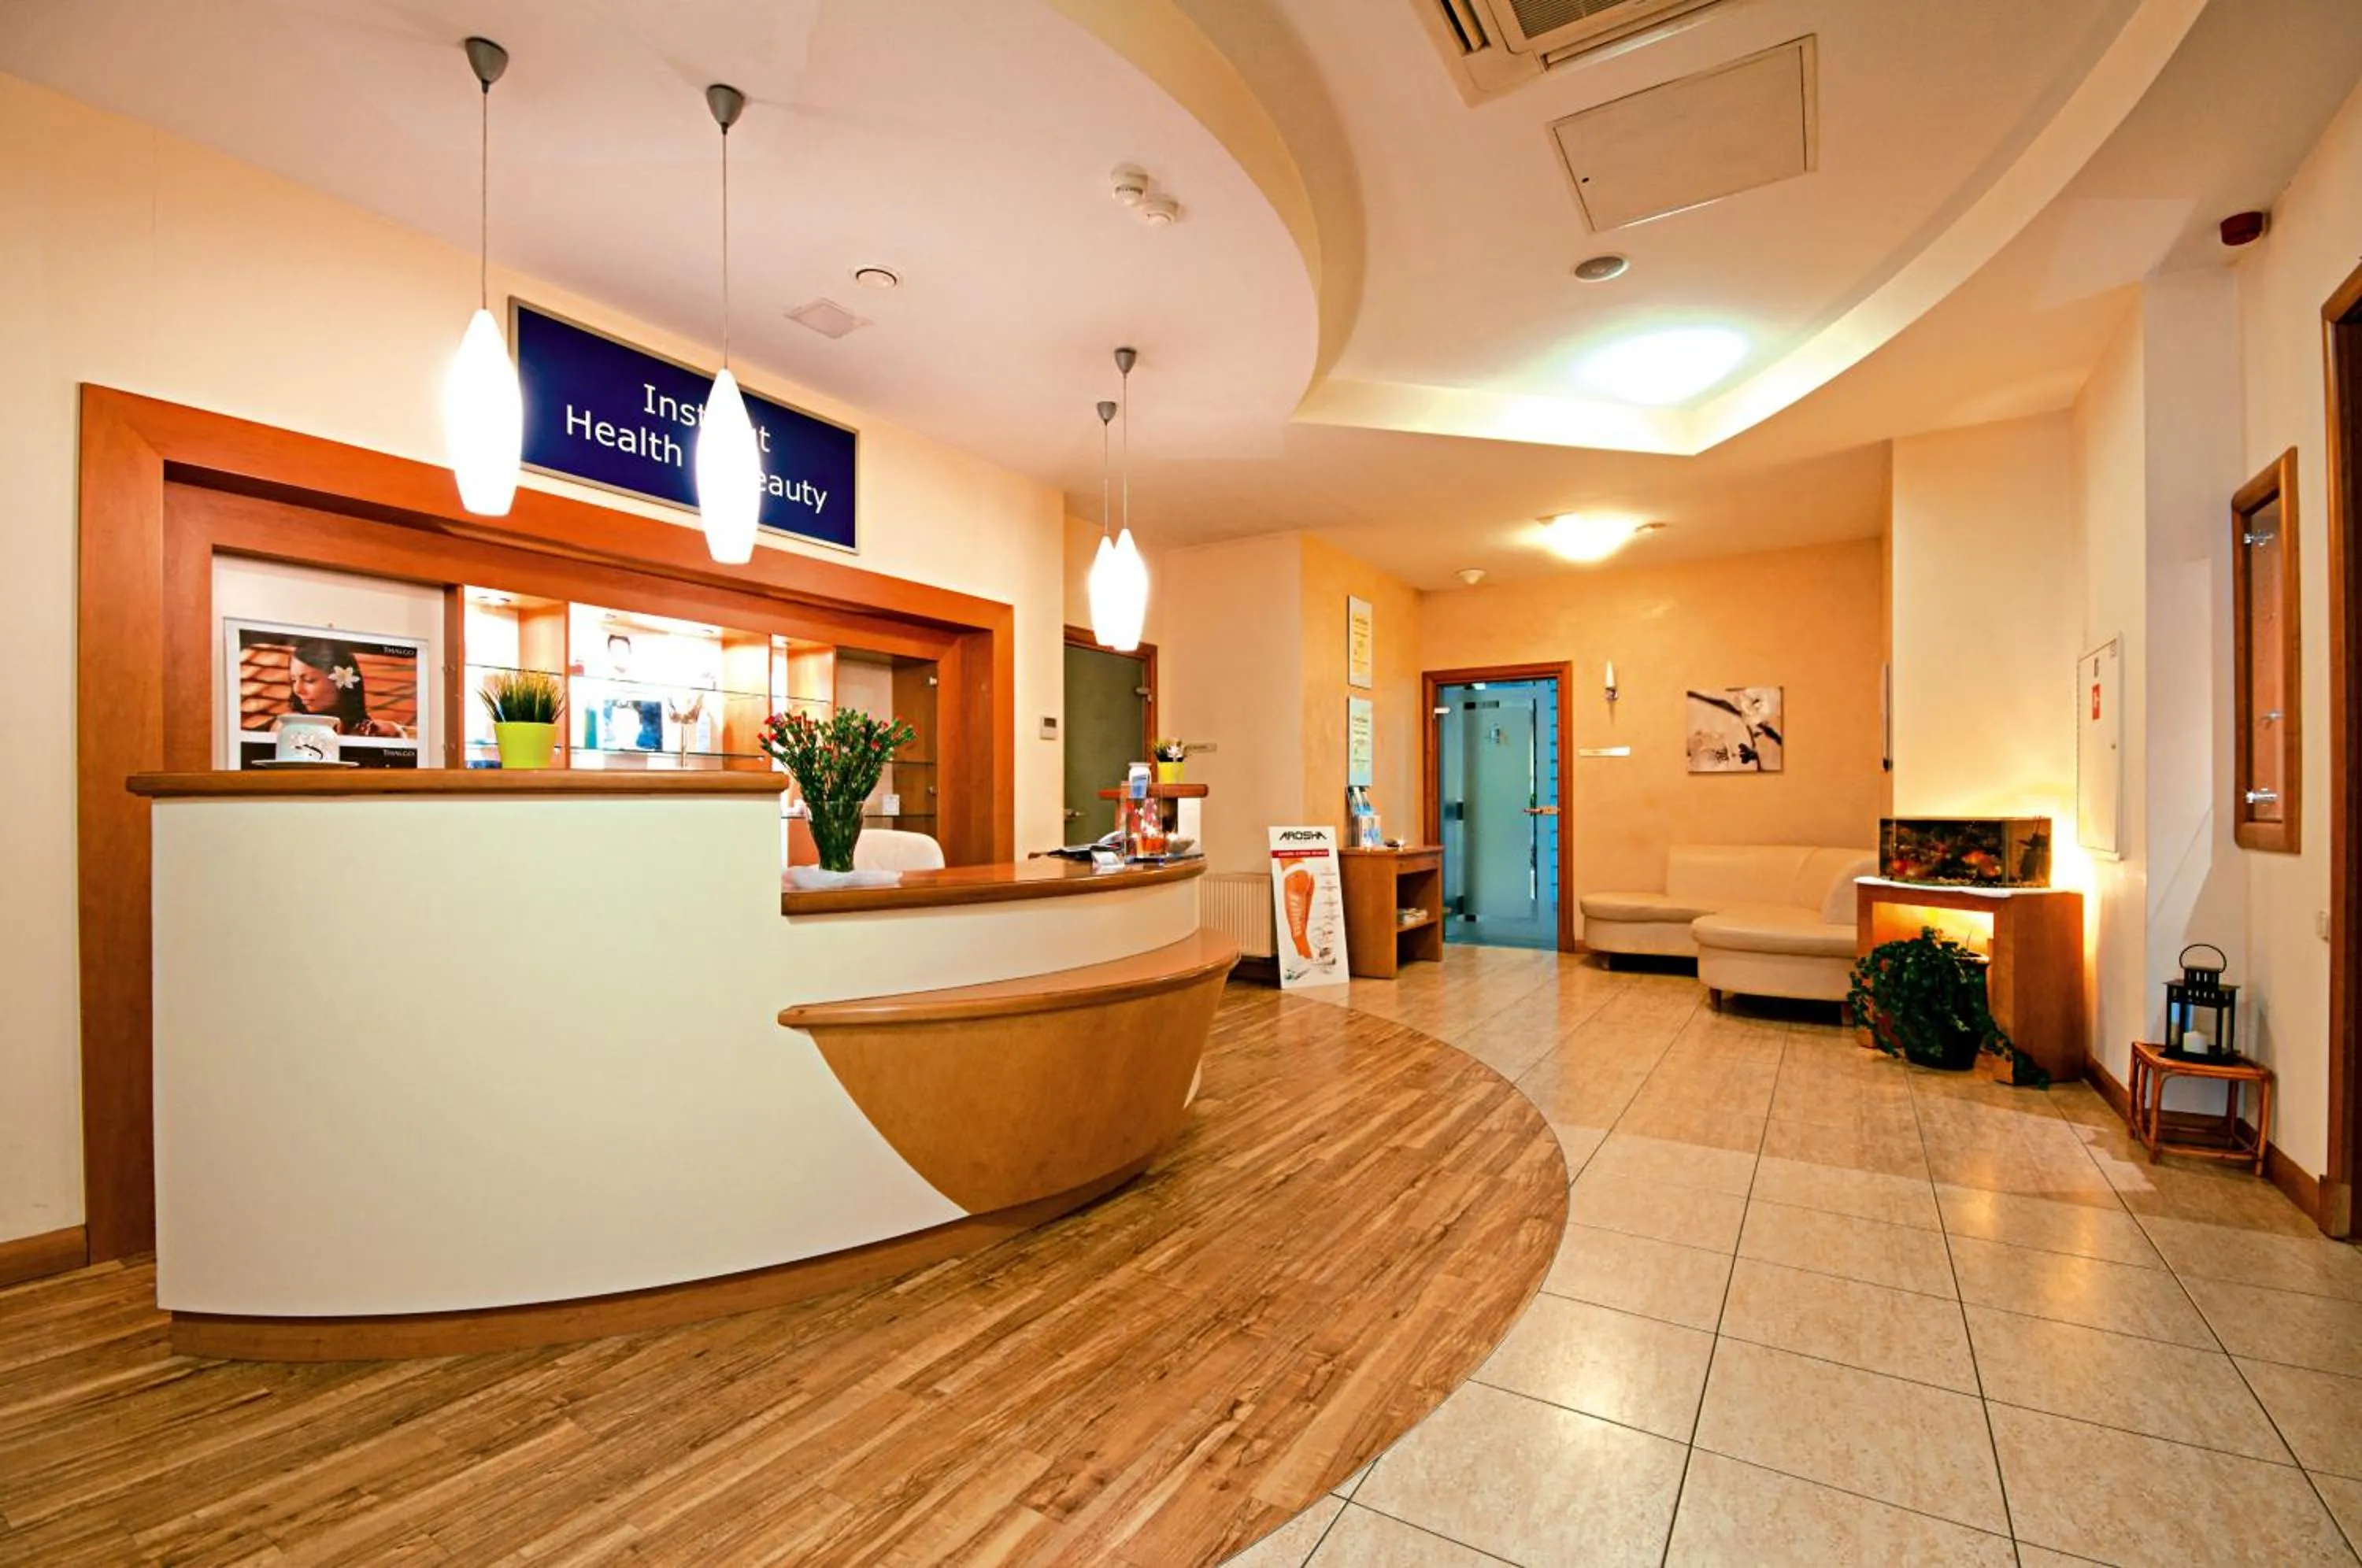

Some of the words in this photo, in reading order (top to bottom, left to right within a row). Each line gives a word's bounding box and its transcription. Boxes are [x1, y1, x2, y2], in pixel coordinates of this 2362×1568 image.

[643, 383, 771, 453] Instt
[566, 404, 683, 467] Health
[757, 472, 827, 514] eauty
[1279, 830, 1327, 841] AROSHA
